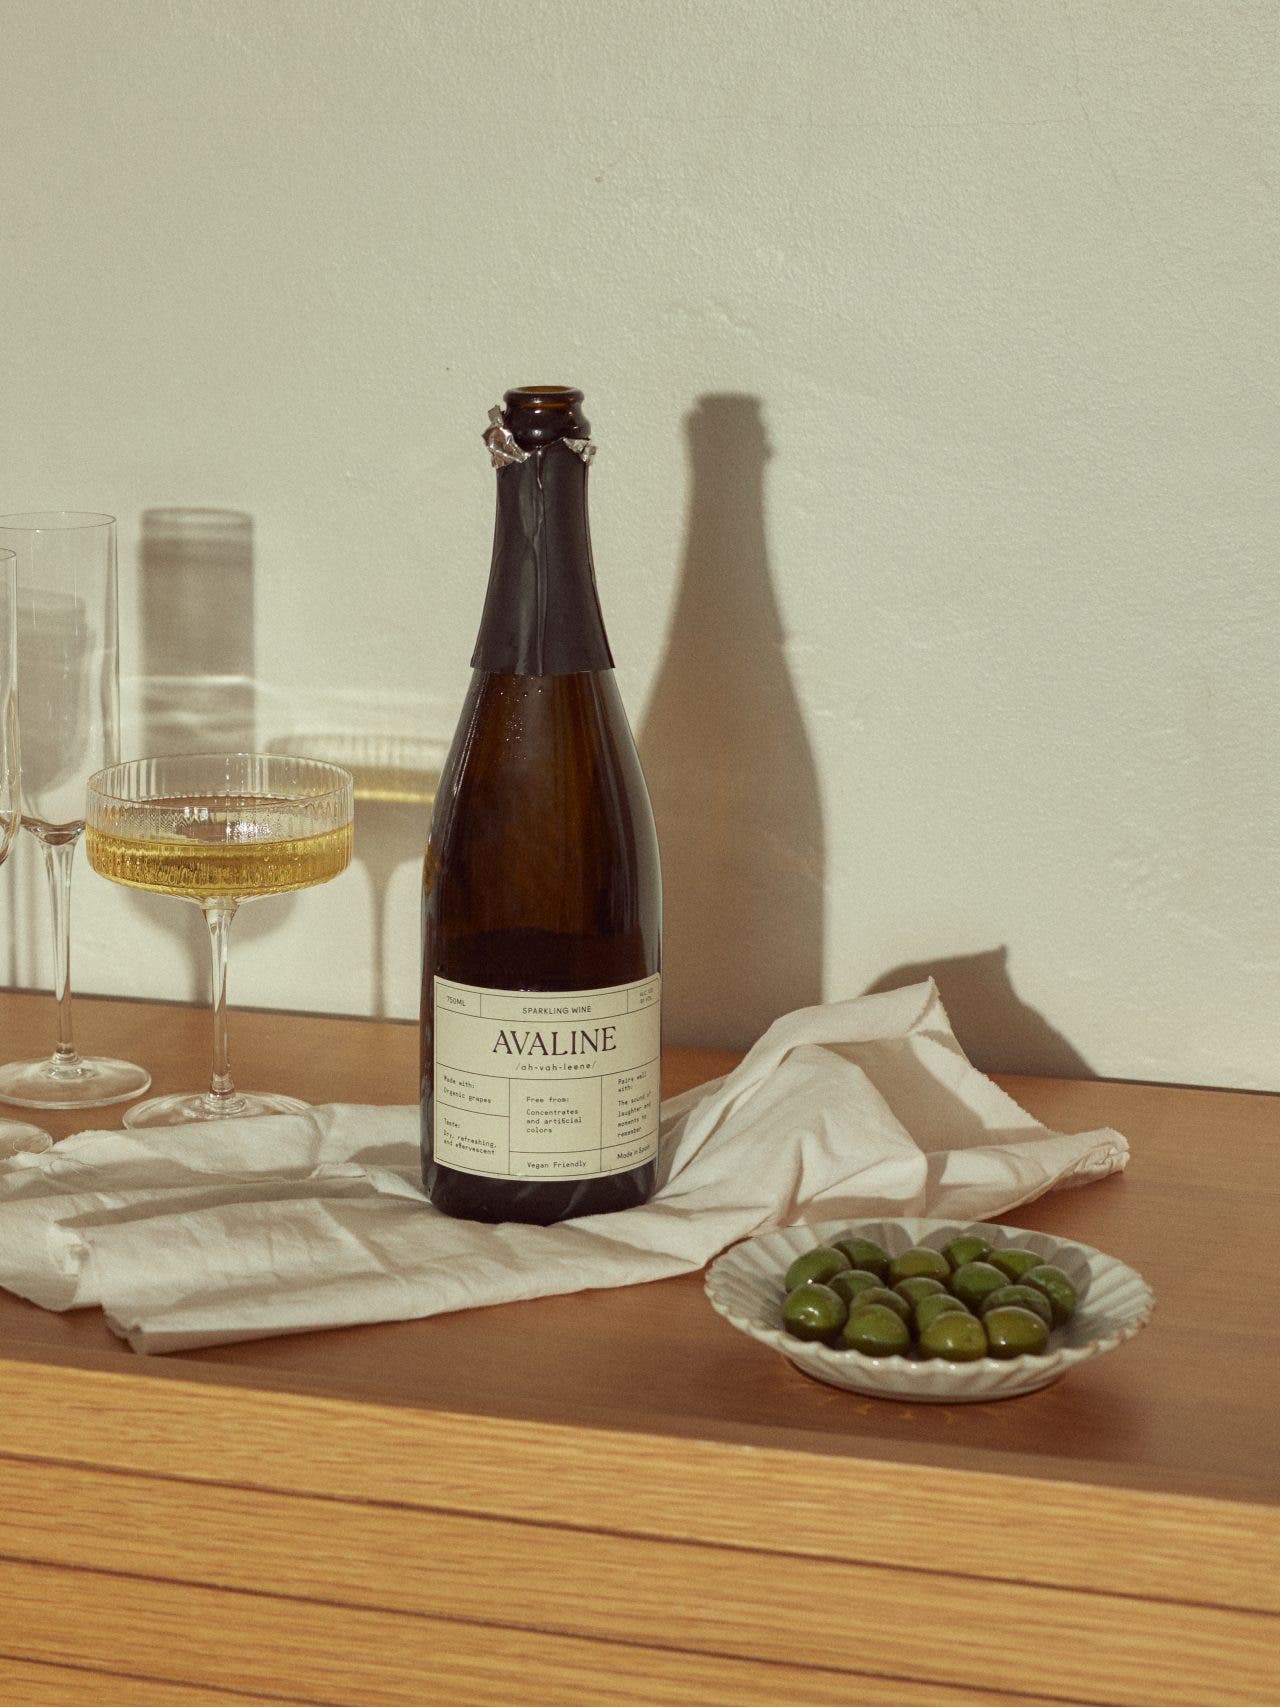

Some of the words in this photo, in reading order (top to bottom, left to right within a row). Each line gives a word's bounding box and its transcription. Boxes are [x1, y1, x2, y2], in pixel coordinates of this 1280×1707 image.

[522, 1006, 569, 1015] SPARKLING
[571, 1005, 592, 1013] WINE
[492, 1026, 617, 1056] AVALINE
[468, 1095, 491, 1104] grapes
[526, 1108, 579, 1116] Concentrates
[526, 1126, 554, 1134] colors
[526, 1161, 550, 1170] Vegan
[553, 1159, 587, 1169] Friendly
